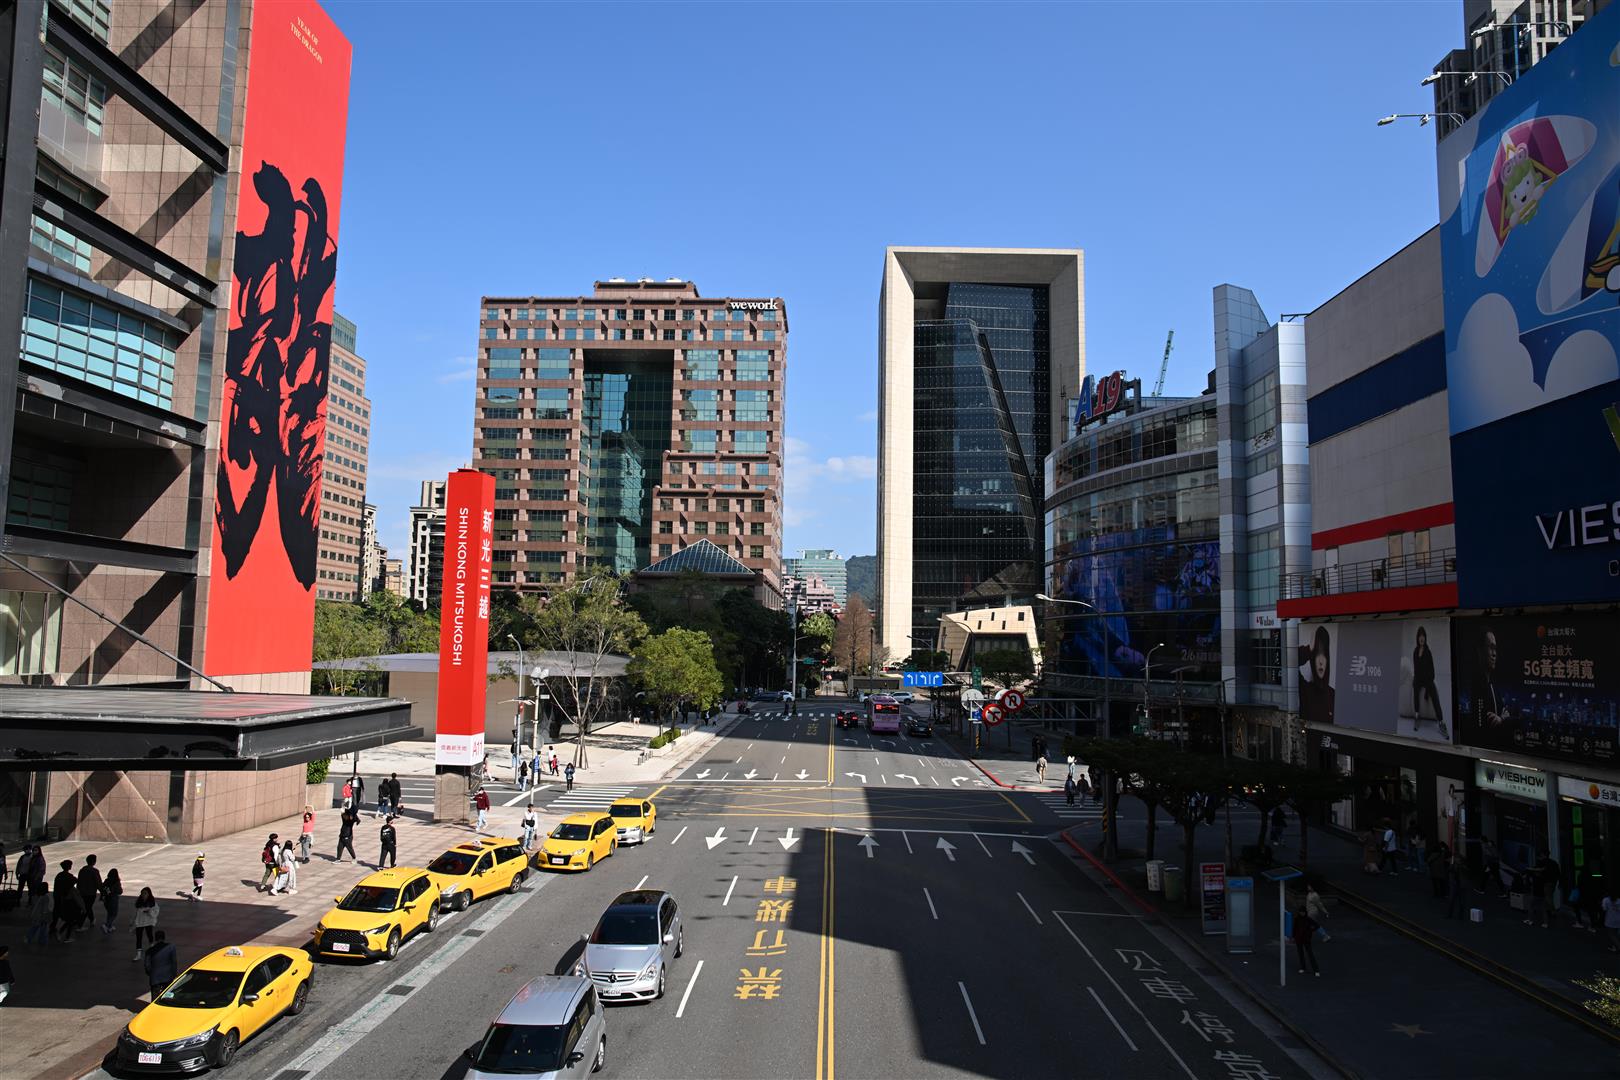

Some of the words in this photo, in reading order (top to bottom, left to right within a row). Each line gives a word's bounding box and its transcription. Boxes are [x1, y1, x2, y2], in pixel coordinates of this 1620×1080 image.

[290, 22, 302, 41] THE
[301, 35, 323, 65] DRAGON
[297, 16, 311, 37] YEAR
[311, 34, 319, 46] OF
[730, 298, 778, 310] wework
[1074, 370, 1121, 425] A19
[459, 507, 469, 540] SHIN
[456, 541, 467, 579] KONG
[478, 509, 492, 619] 新光三越
[452, 581, 466, 666] MITSUKOSHI
[1541, 644, 1573, 657] 全台最大
[1523, 659, 1594, 679] 5G黃金頻寬
[472, 740, 482, 757] A11
[1498, 770, 1545, 788] VIESHOW
[1602, 789, 1620, 802] 台灣
